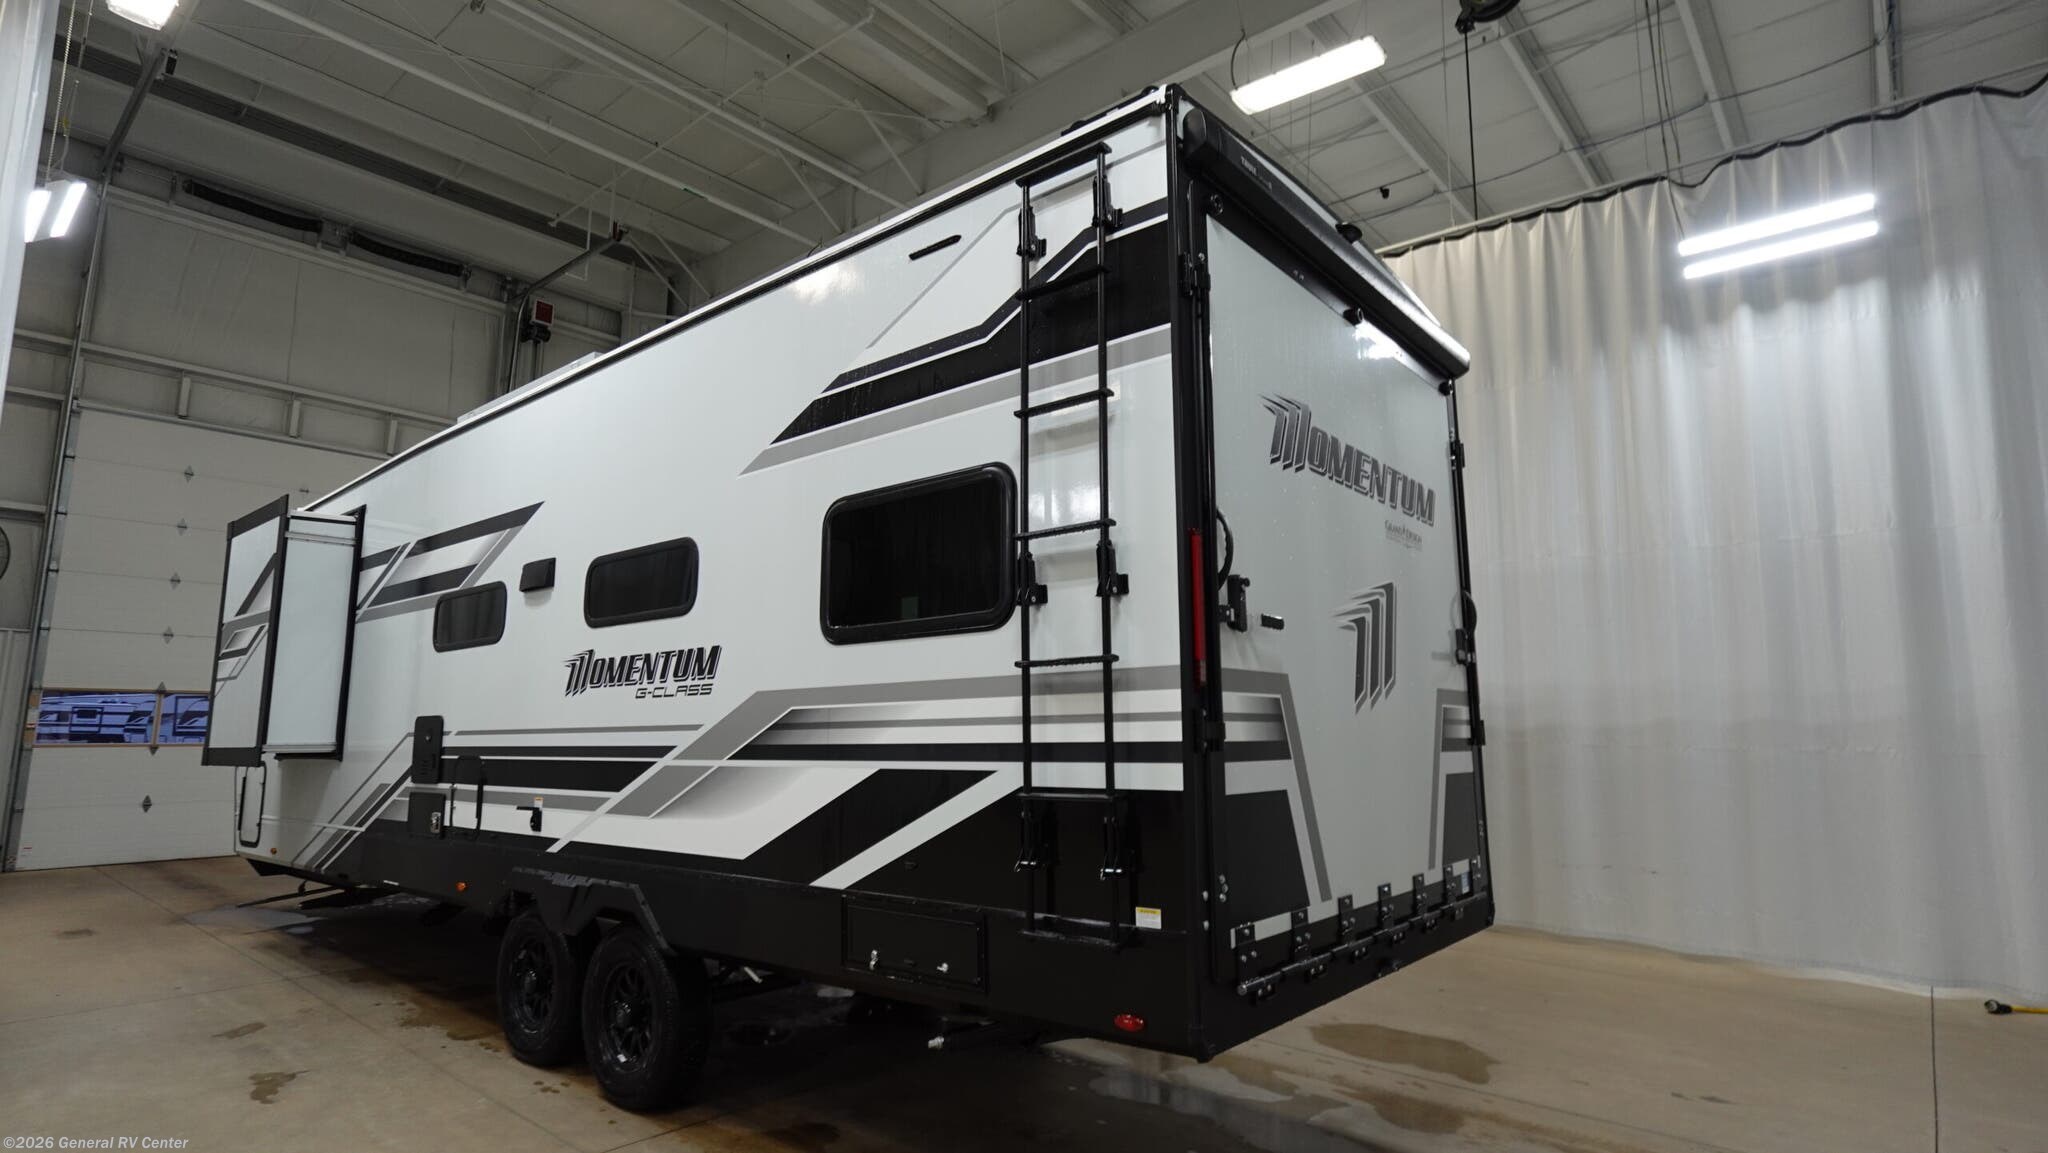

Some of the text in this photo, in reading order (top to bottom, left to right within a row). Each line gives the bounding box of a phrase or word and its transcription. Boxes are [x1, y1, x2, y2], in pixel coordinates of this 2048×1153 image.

[1260, 393, 1436, 527] MOMENTUM
[563, 645, 722, 697] MOMENTUM
[635, 683, 714, 699] G-CLASS
